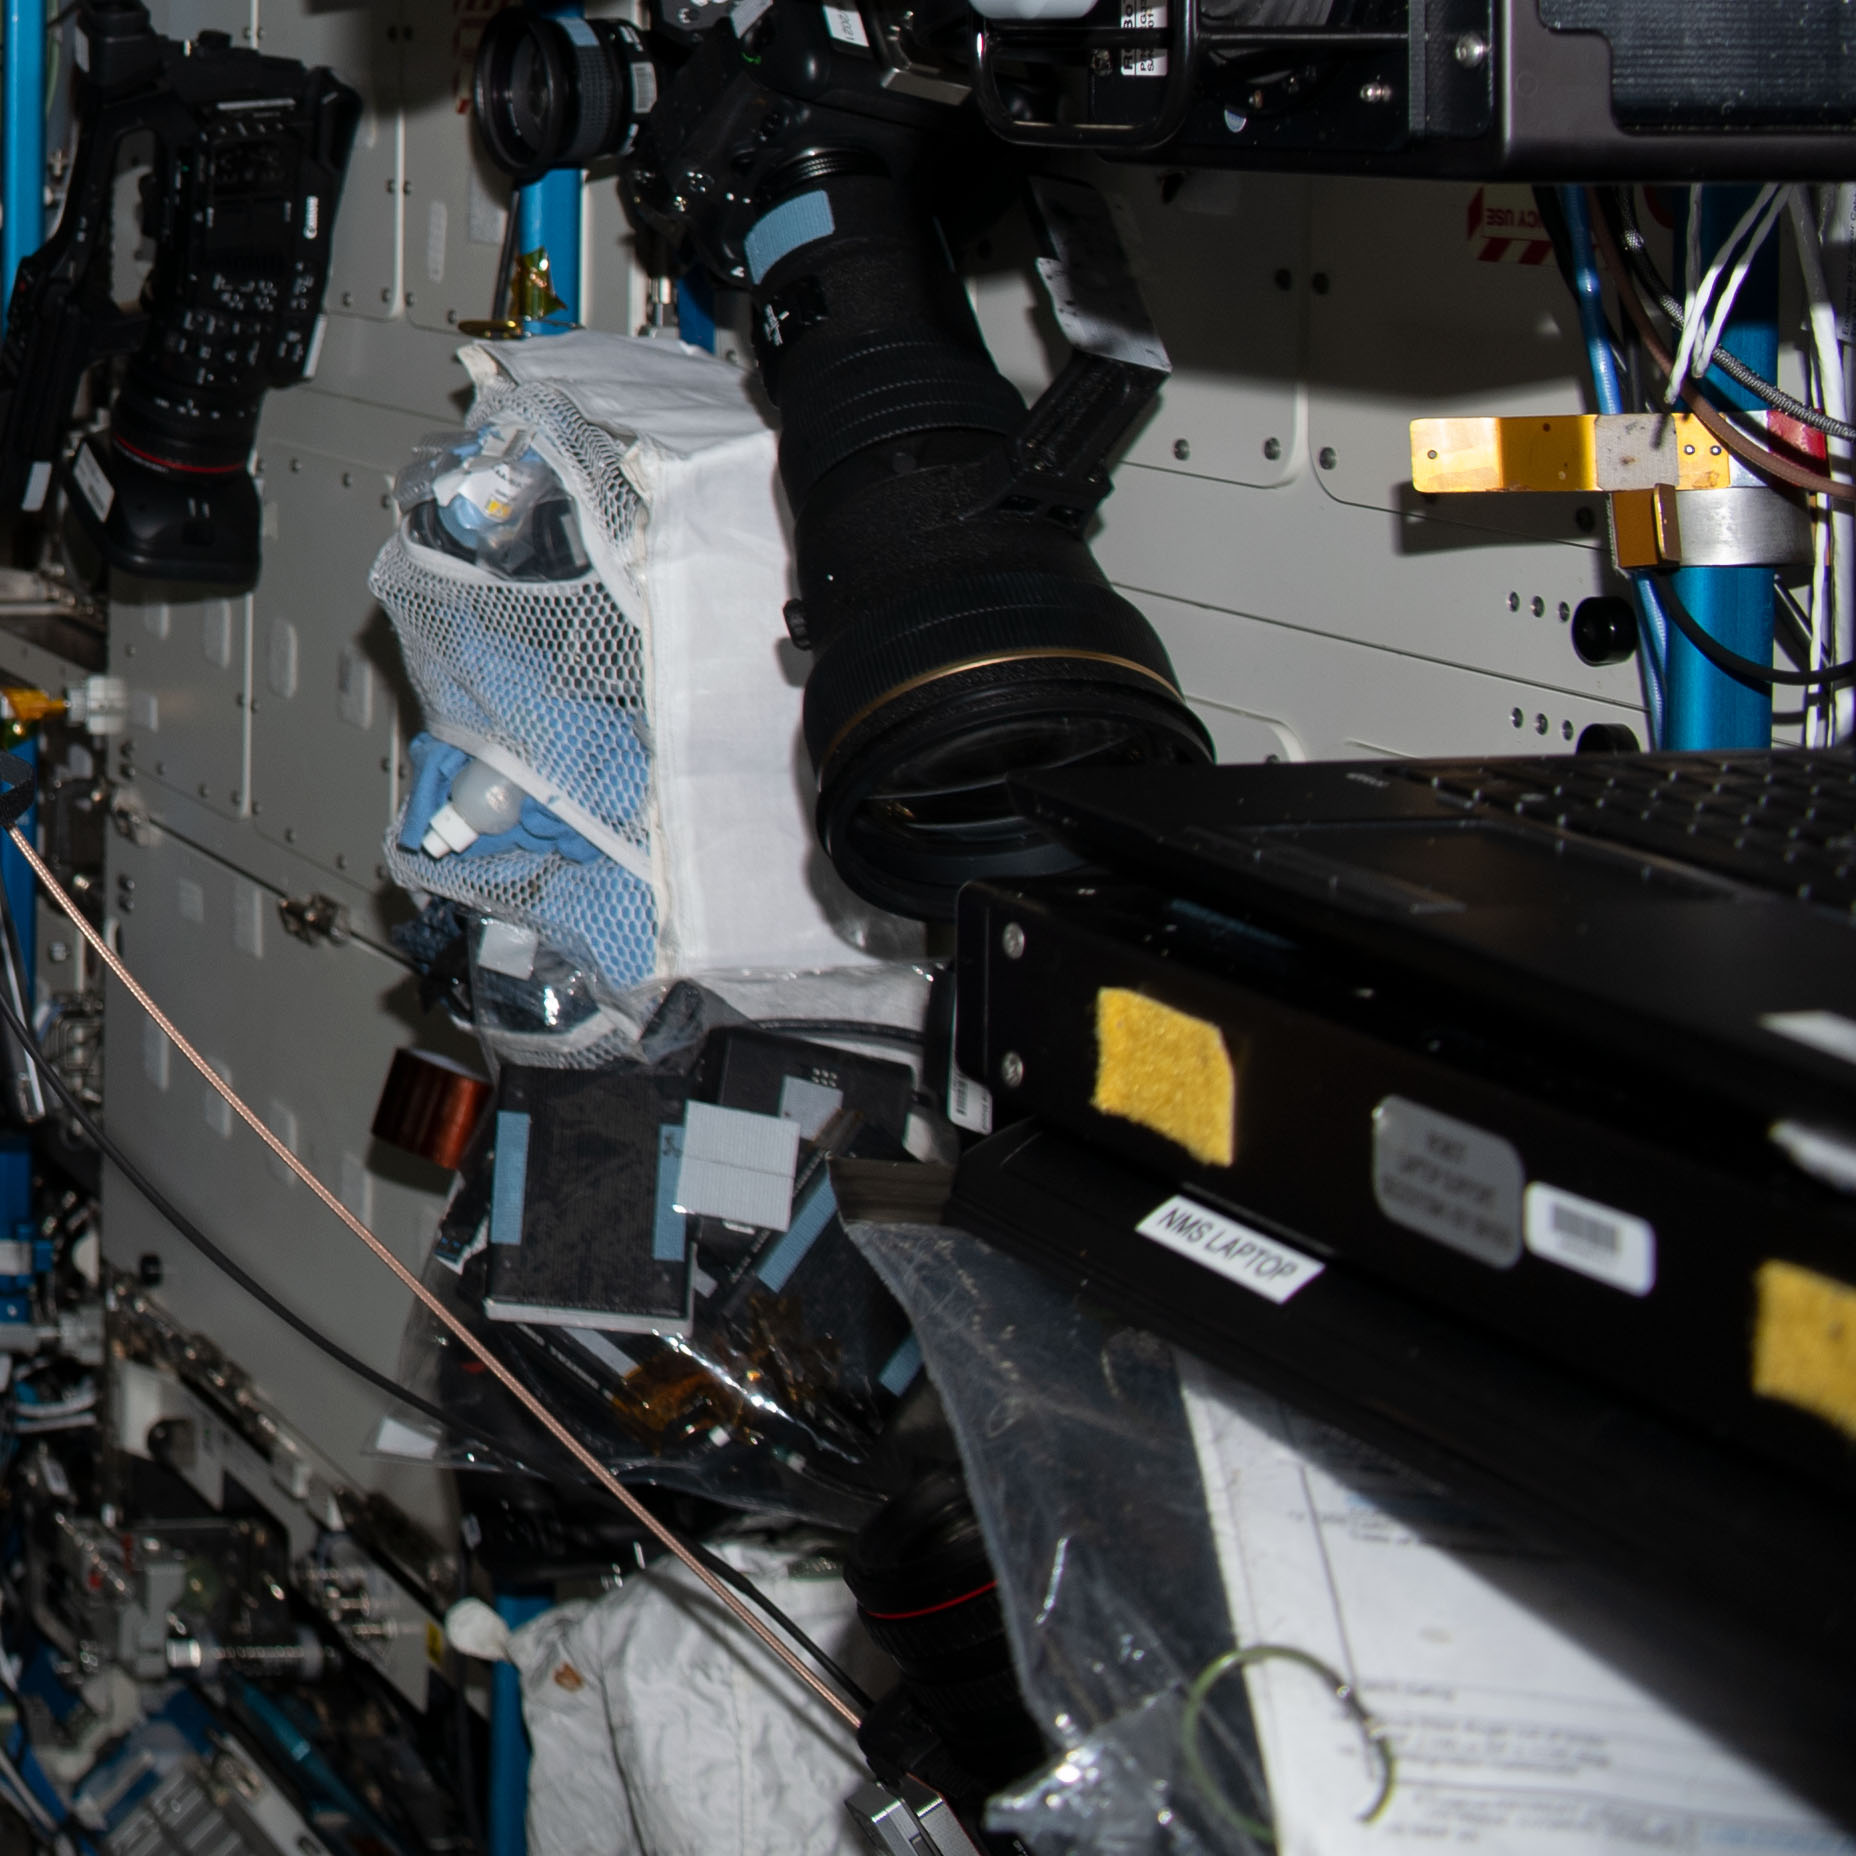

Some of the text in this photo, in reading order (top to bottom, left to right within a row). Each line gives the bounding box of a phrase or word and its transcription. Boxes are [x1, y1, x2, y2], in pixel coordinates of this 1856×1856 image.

[1485, 208, 1513, 225] USE
[1156, 1207, 1298, 1284] NMS LAPTOP
